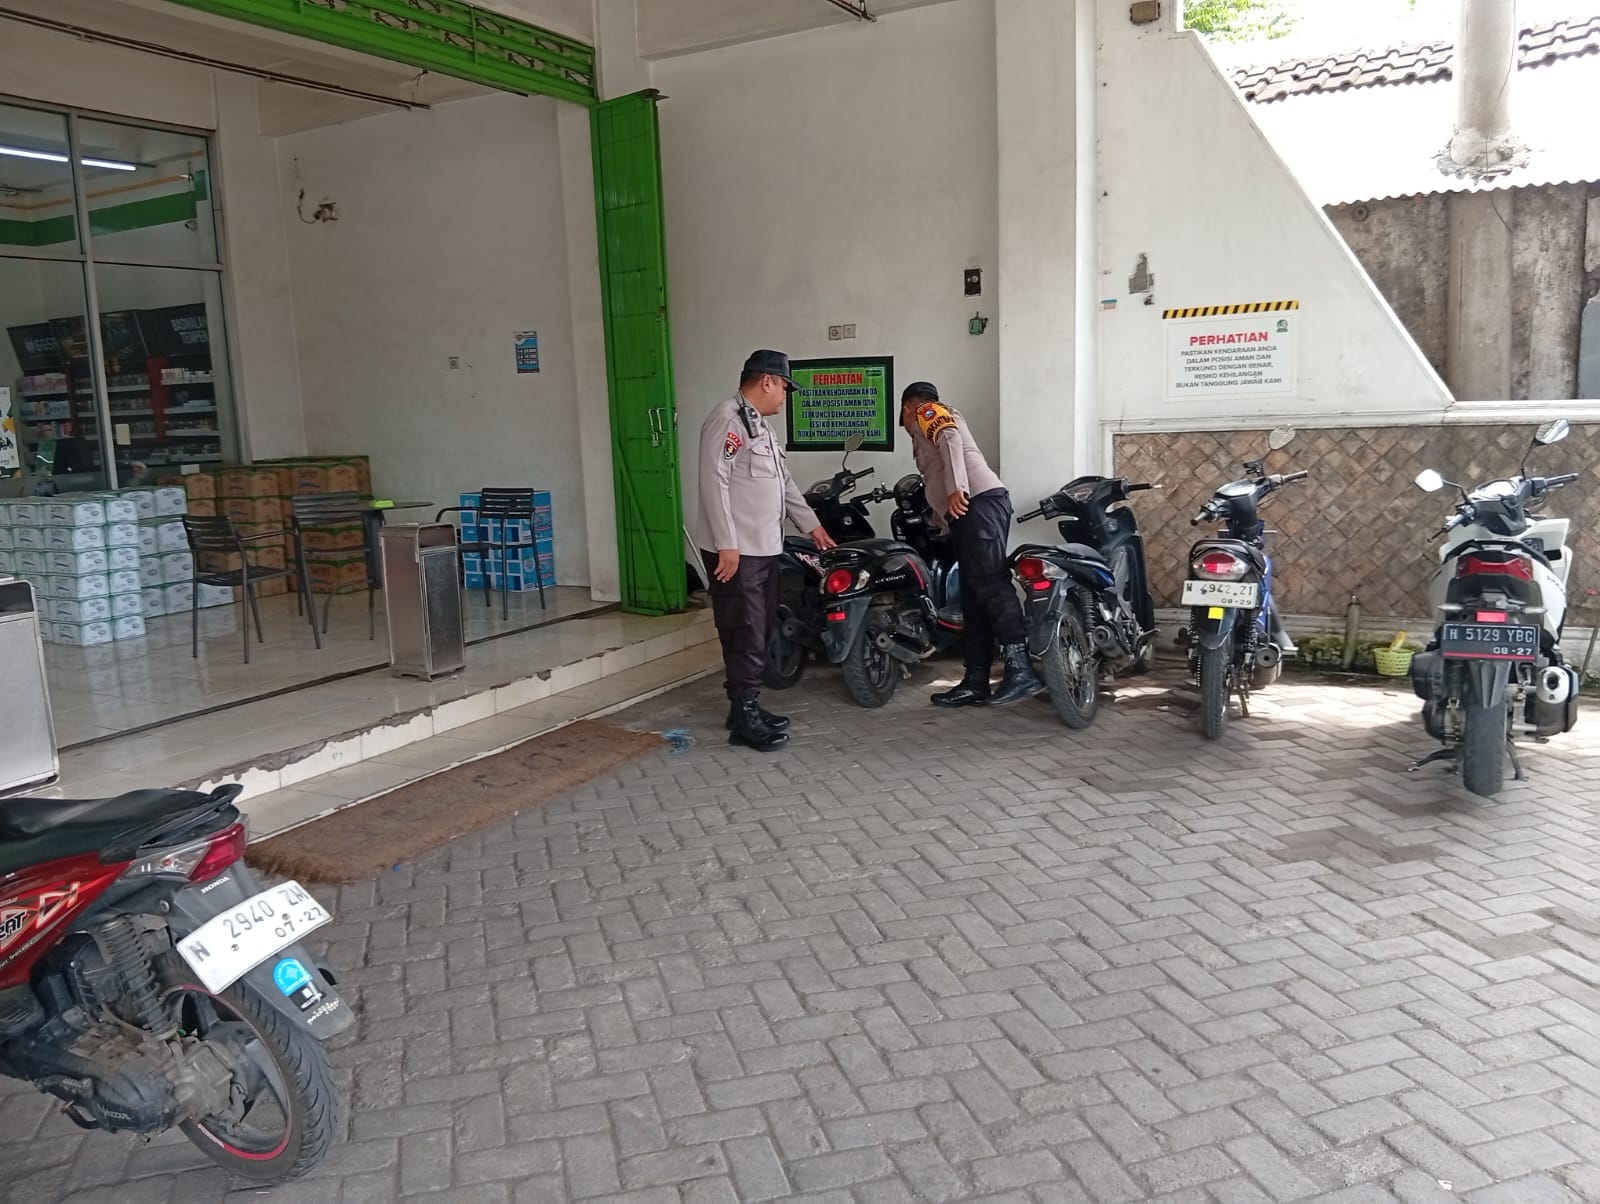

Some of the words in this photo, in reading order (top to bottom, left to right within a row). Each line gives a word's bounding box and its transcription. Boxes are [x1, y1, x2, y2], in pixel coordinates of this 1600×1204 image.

[1189, 331, 1269, 346] PERHATIAN
[1181, 348, 1213, 356] PASTIKAN
[1214, 346, 1256, 355] KENDARAAN
[1211, 355, 1233, 363] POSISI
[1184, 364, 1217, 372] TERKUNCI
[1219, 370, 1263, 378] KEHILANGAN
[813, 373, 863, 386] PERHATIAN
[1200, 380, 1238, 388] TANGGUNG
[799, 388, 826, 397] PASTIKAN
[861, 387, 878, 396] ANDA
[801, 399, 821, 408] DALAM
[822, 399, 843, 407] POSISI
[843, 399, 862, 407] AMAN
[1465, 628, 1500, 642] 5129
[1507, 629, 1533, 643] YBG
[200, 876, 231, 894] HONDA
[189, 939, 211, 963] N
[222, 899, 275, 939] 2940
